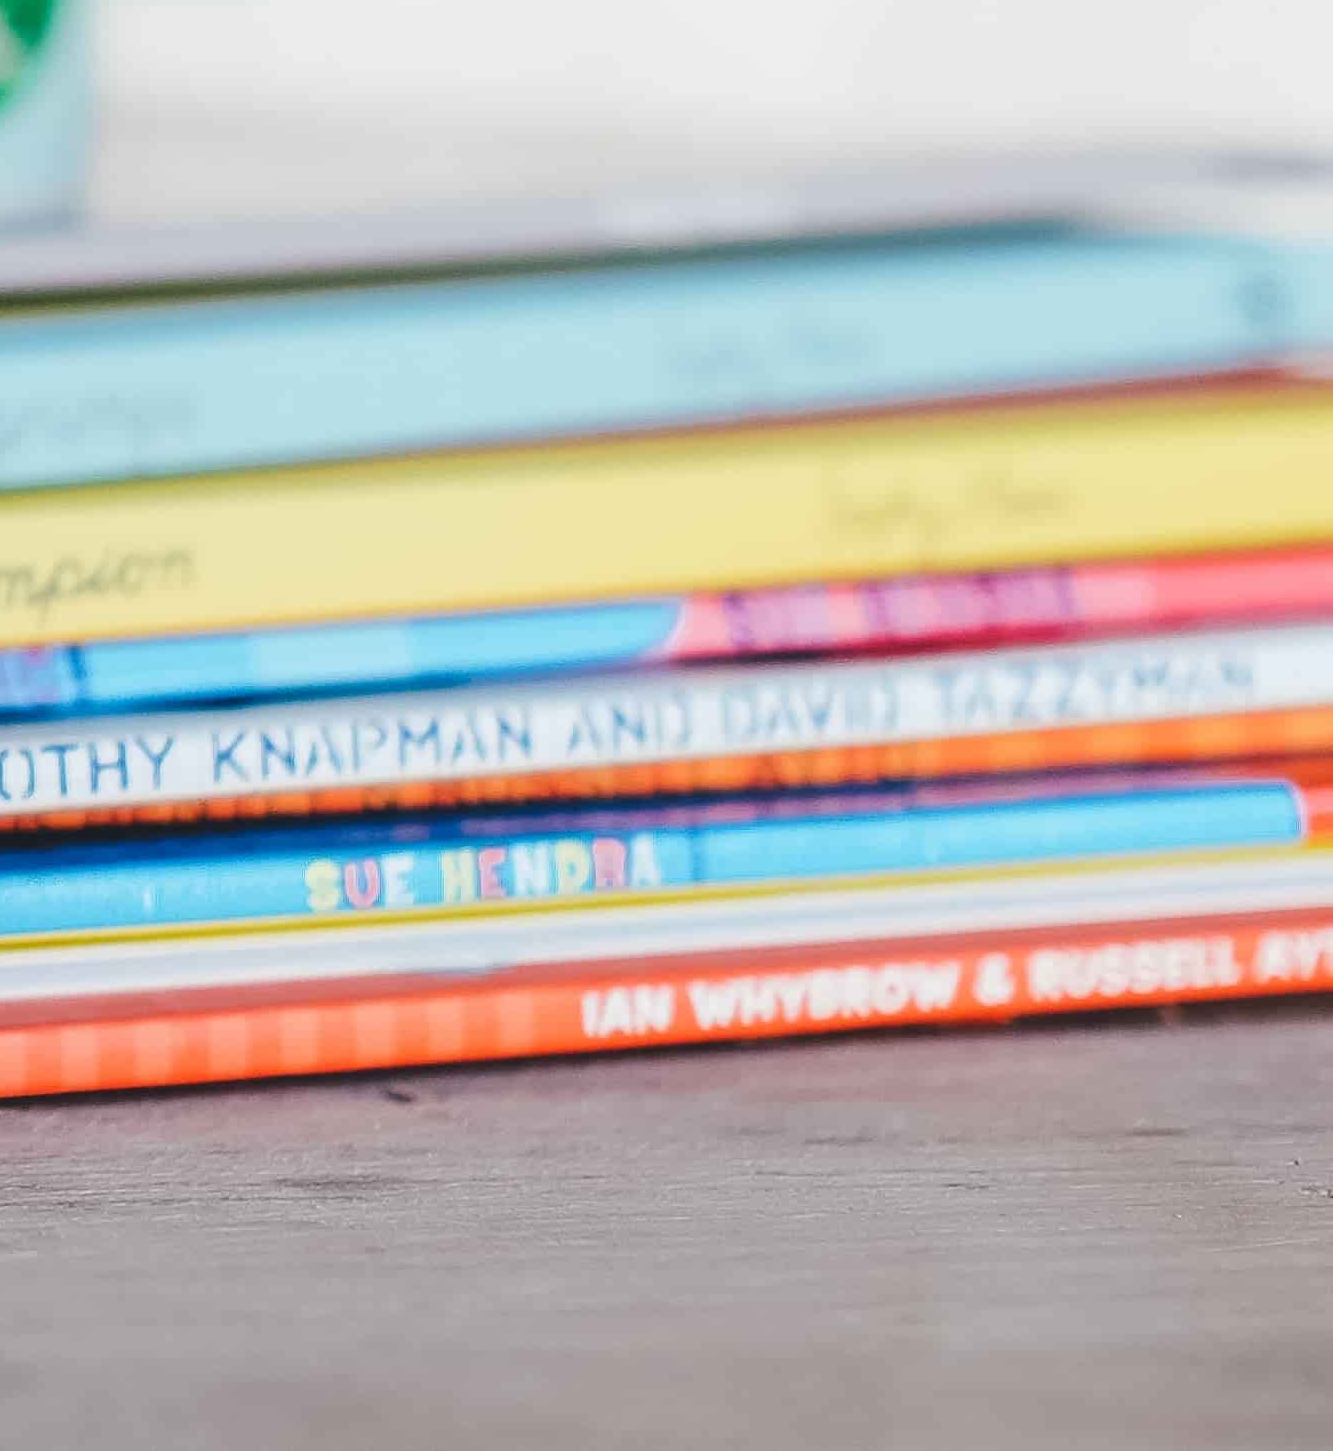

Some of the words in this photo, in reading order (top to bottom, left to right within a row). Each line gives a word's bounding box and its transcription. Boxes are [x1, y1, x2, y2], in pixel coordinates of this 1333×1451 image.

[211, 707, 533, 783] KNAPMAN
[568, 693, 691, 753] AND
[724, 676, 899, 740] DAVID
[304, 853, 416, 914] SUE
[440, 832, 663, 902] HENDRA
[581, 984, 675, 1038] IAN
[688, 960, 961, 1031] WHYBROW
[972, 953, 1015, 1006] &
[1026, 936, 1241, 1003] RUSSELL
